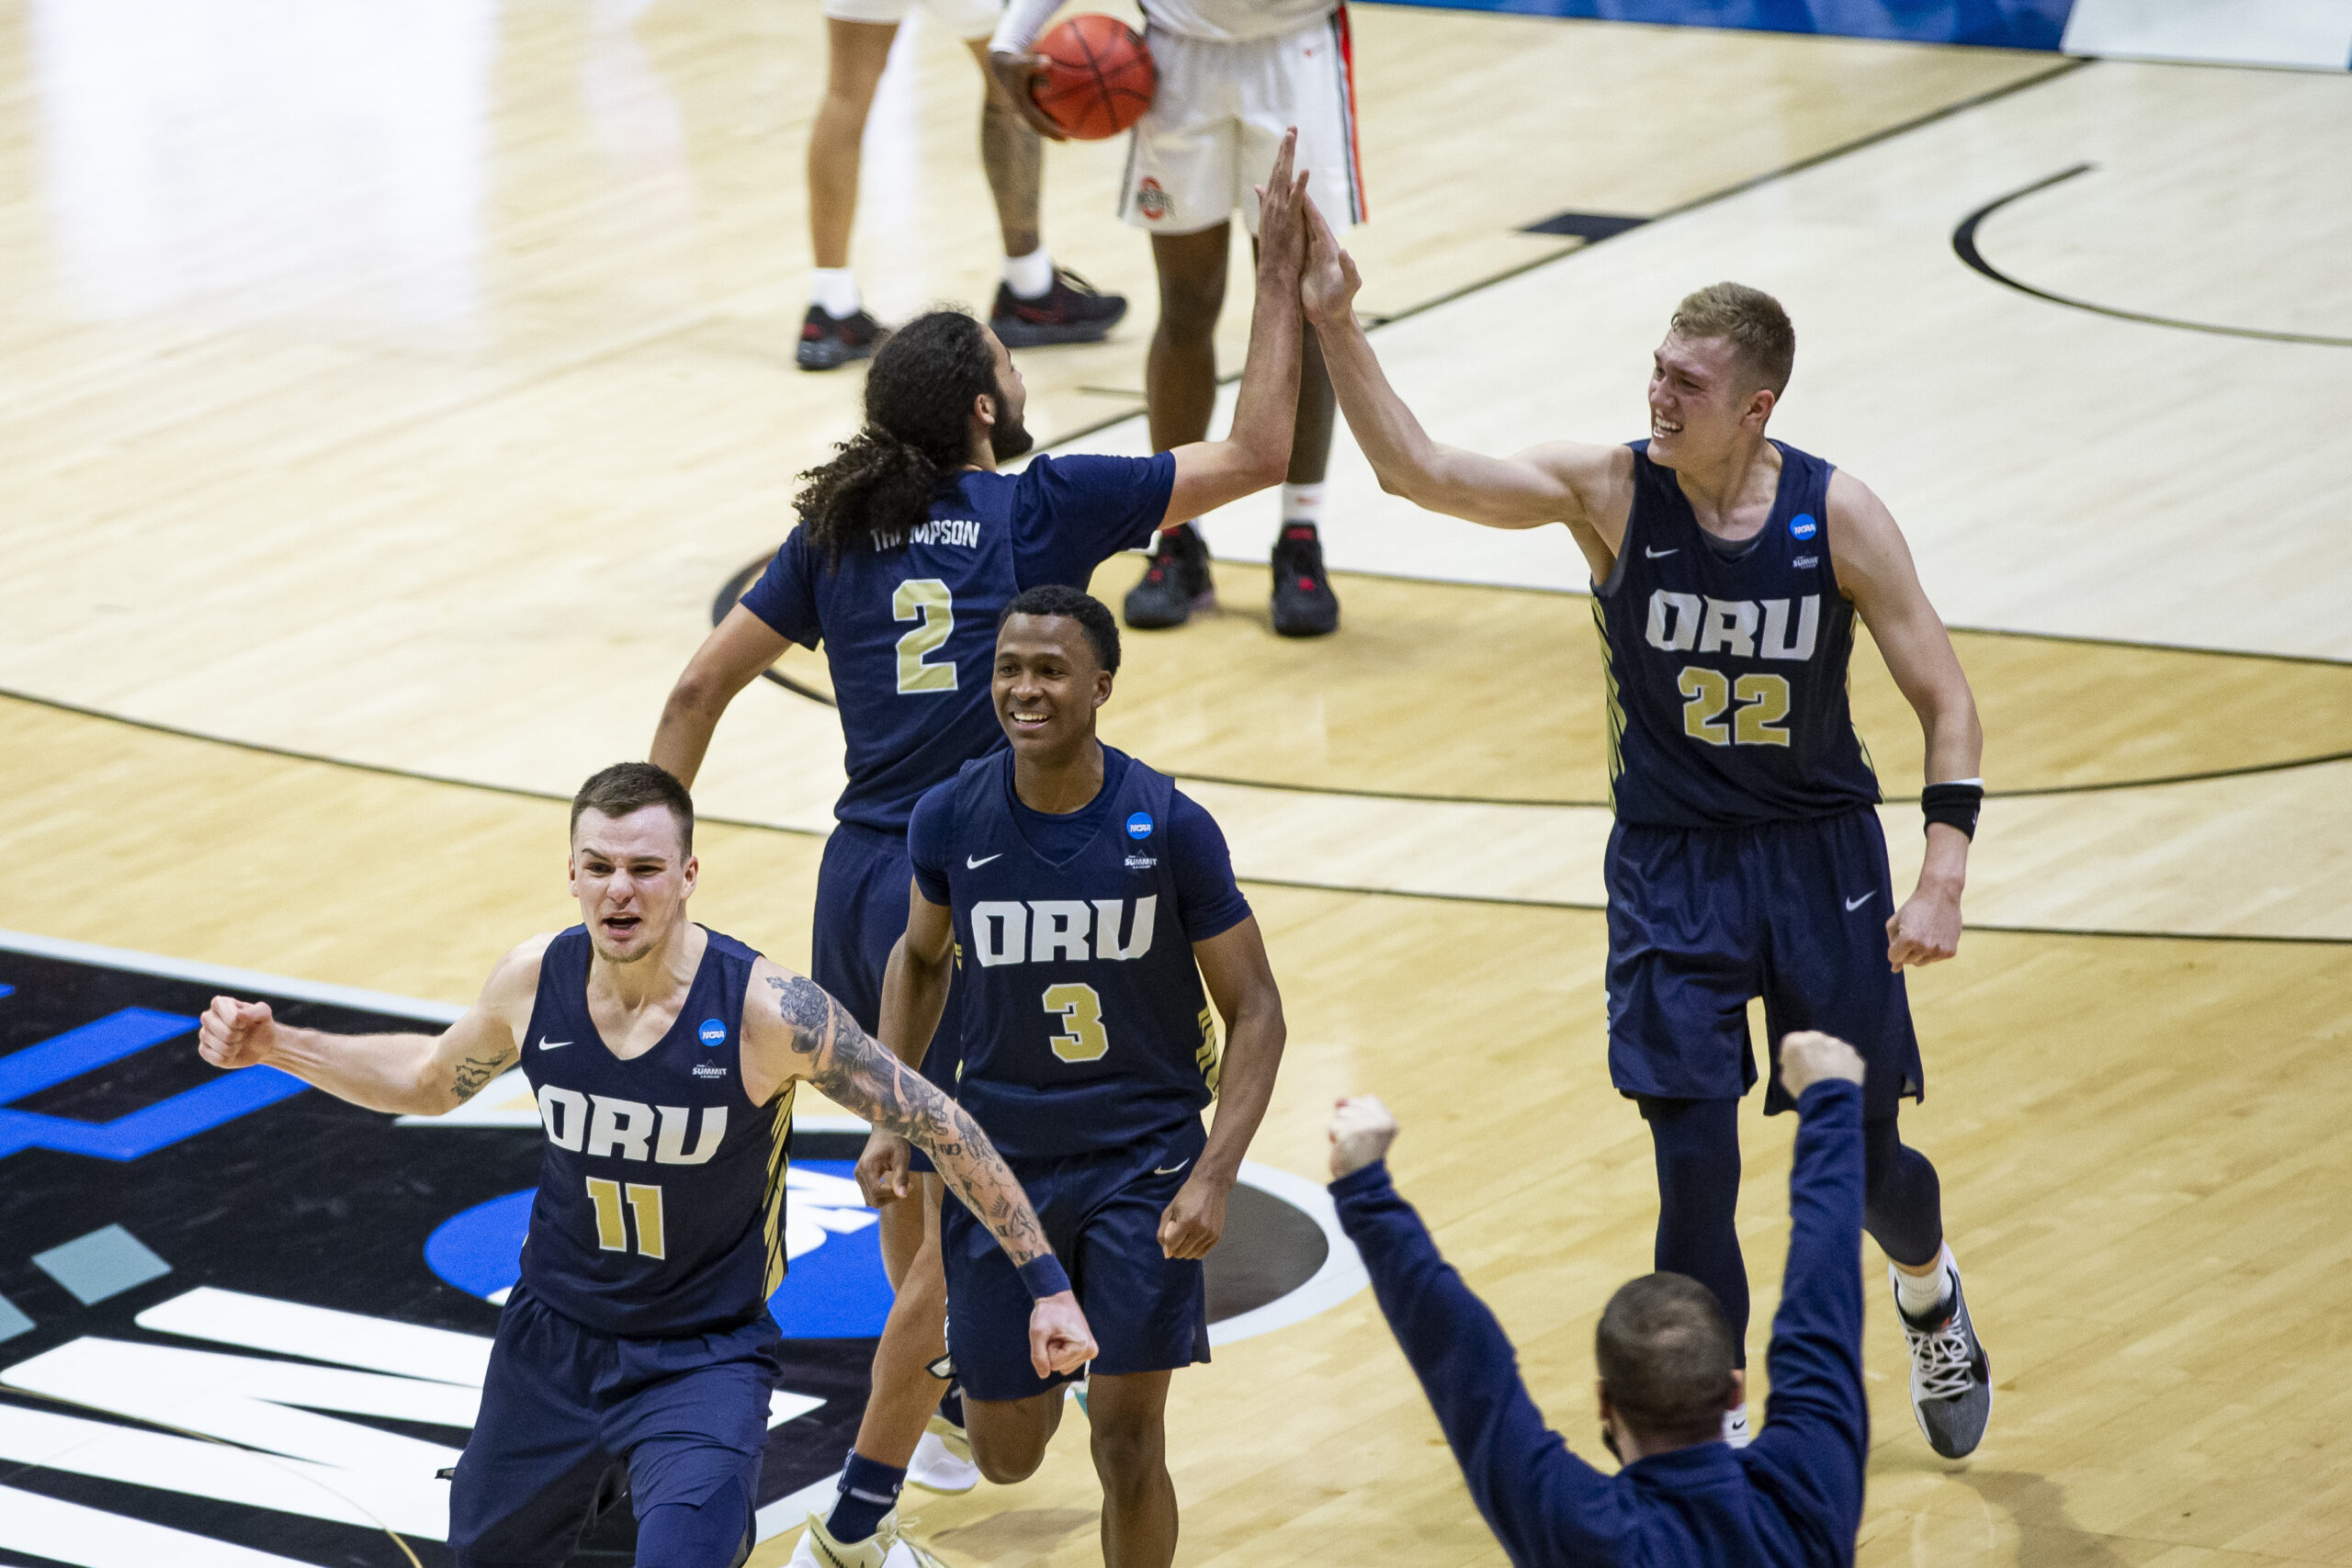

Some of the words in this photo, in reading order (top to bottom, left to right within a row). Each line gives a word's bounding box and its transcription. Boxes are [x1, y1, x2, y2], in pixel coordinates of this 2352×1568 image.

[870, 520, 980, 551] THMPSON
[893, 579, 958, 694] 2
[1645, 589, 1820, 660] ORU
[1678, 666, 1790, 748] 22
[1125, 858, 1157, 866] SUMMIT
[1129, 824, 1151, 832] NCAA
[970, 894, 1158, 967] ORU
[702, 1031, 725, 1040] NCAA
[1042, 982, 1109, 1063] 3
[537, 1084, 729, 1165] ORU
[585, 1176, 665, 1260] 11
